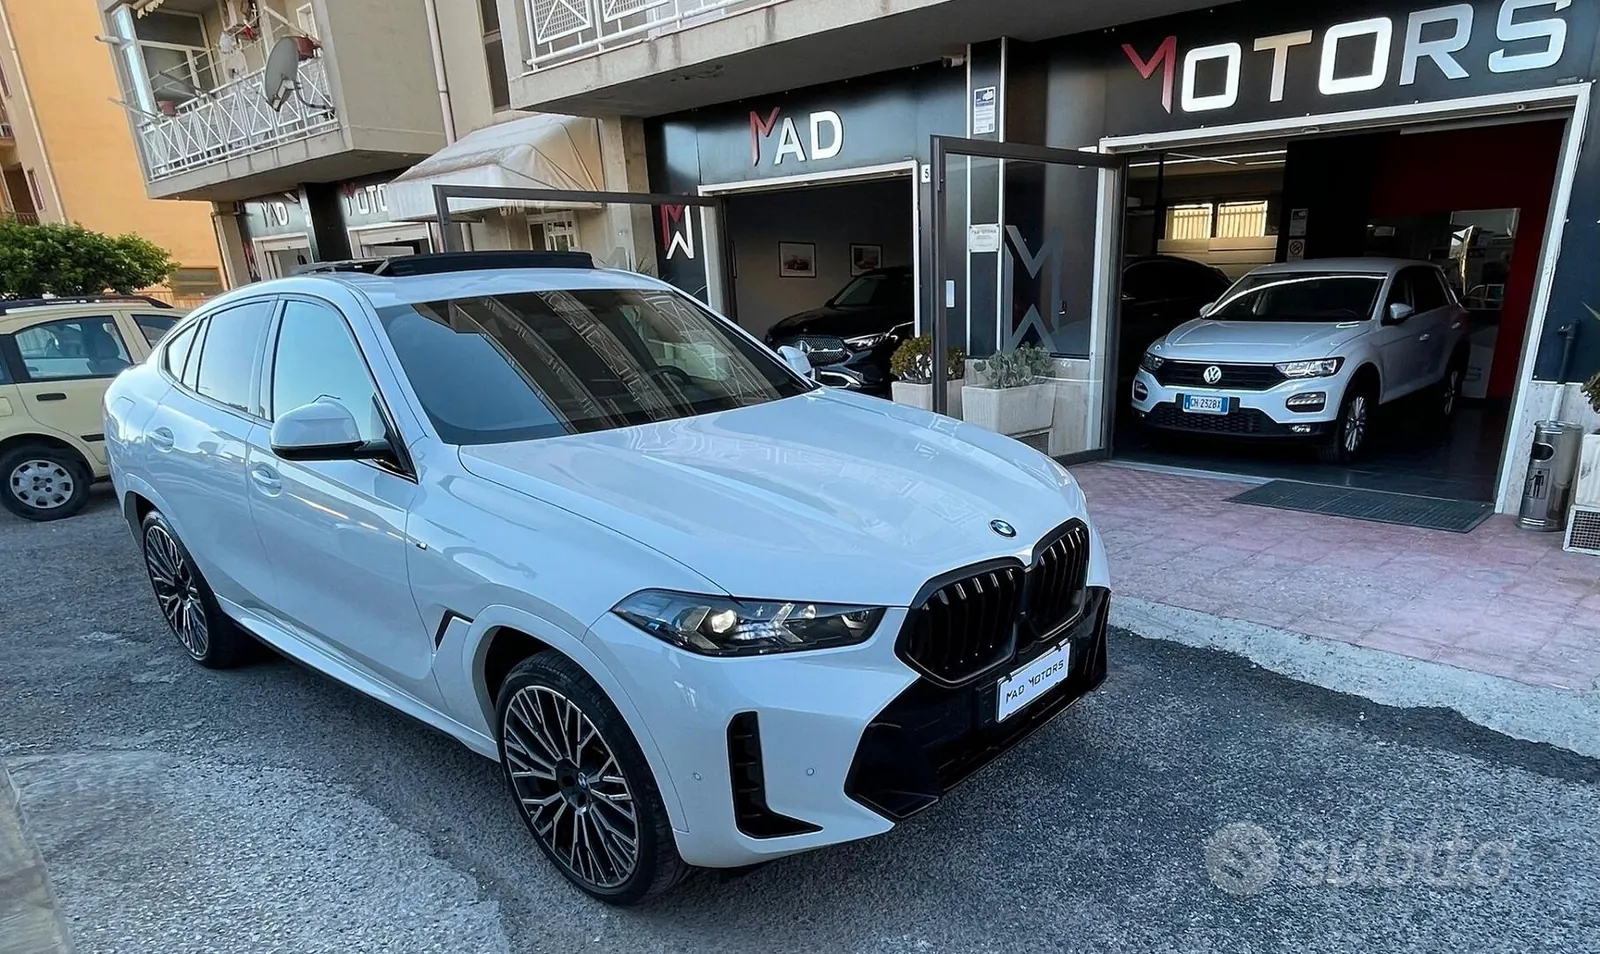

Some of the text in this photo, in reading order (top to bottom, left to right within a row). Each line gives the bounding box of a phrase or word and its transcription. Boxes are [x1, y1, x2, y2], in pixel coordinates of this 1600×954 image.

[1121, 0, 1572, 115] MOTORS
[750, 106, 844, 166] MAD
[1006, 660, 1064, 704] MAD MOTORS
